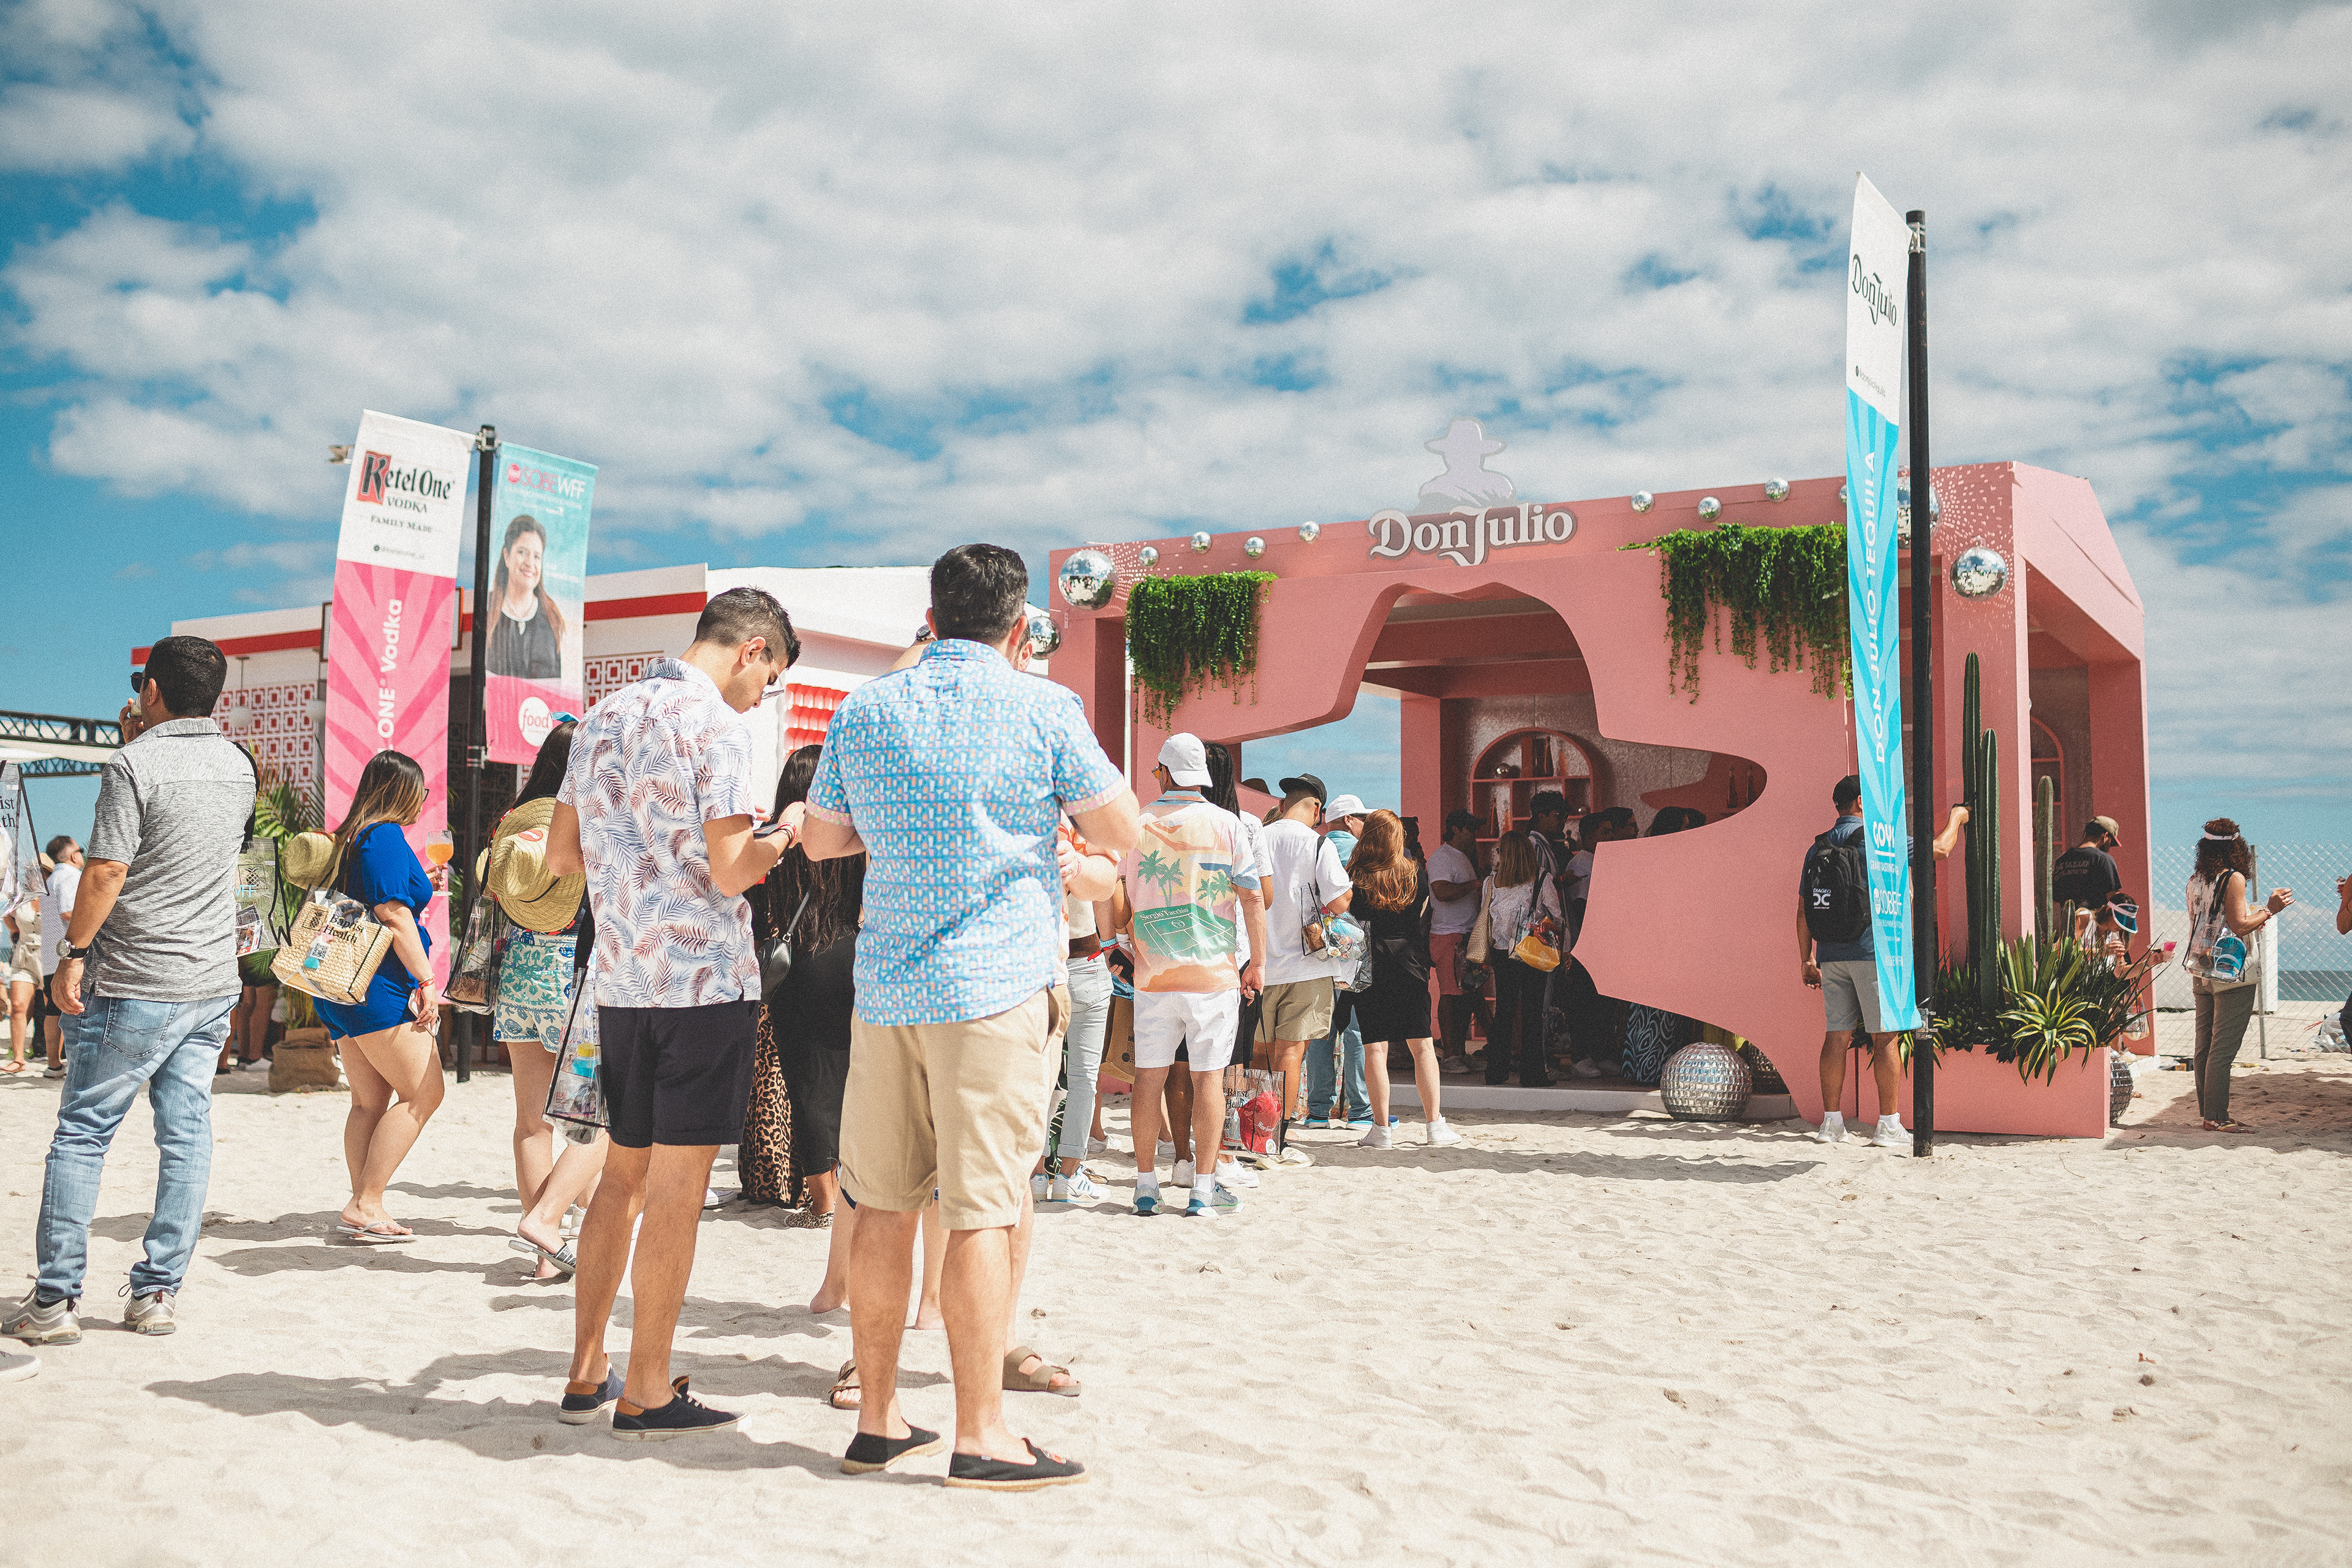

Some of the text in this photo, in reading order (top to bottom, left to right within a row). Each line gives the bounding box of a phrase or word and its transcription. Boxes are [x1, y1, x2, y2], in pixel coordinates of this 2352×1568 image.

[361, 454, 418, 502] Ketel
[387, 496, 428, 513] VODKA
[1864, 451, 1885, 764] DON JULIO TEQUILA
[380, 598, 402, 673] Vodka
[519, 707, 550, 733] food
[323, 924, 358, 943] Health
